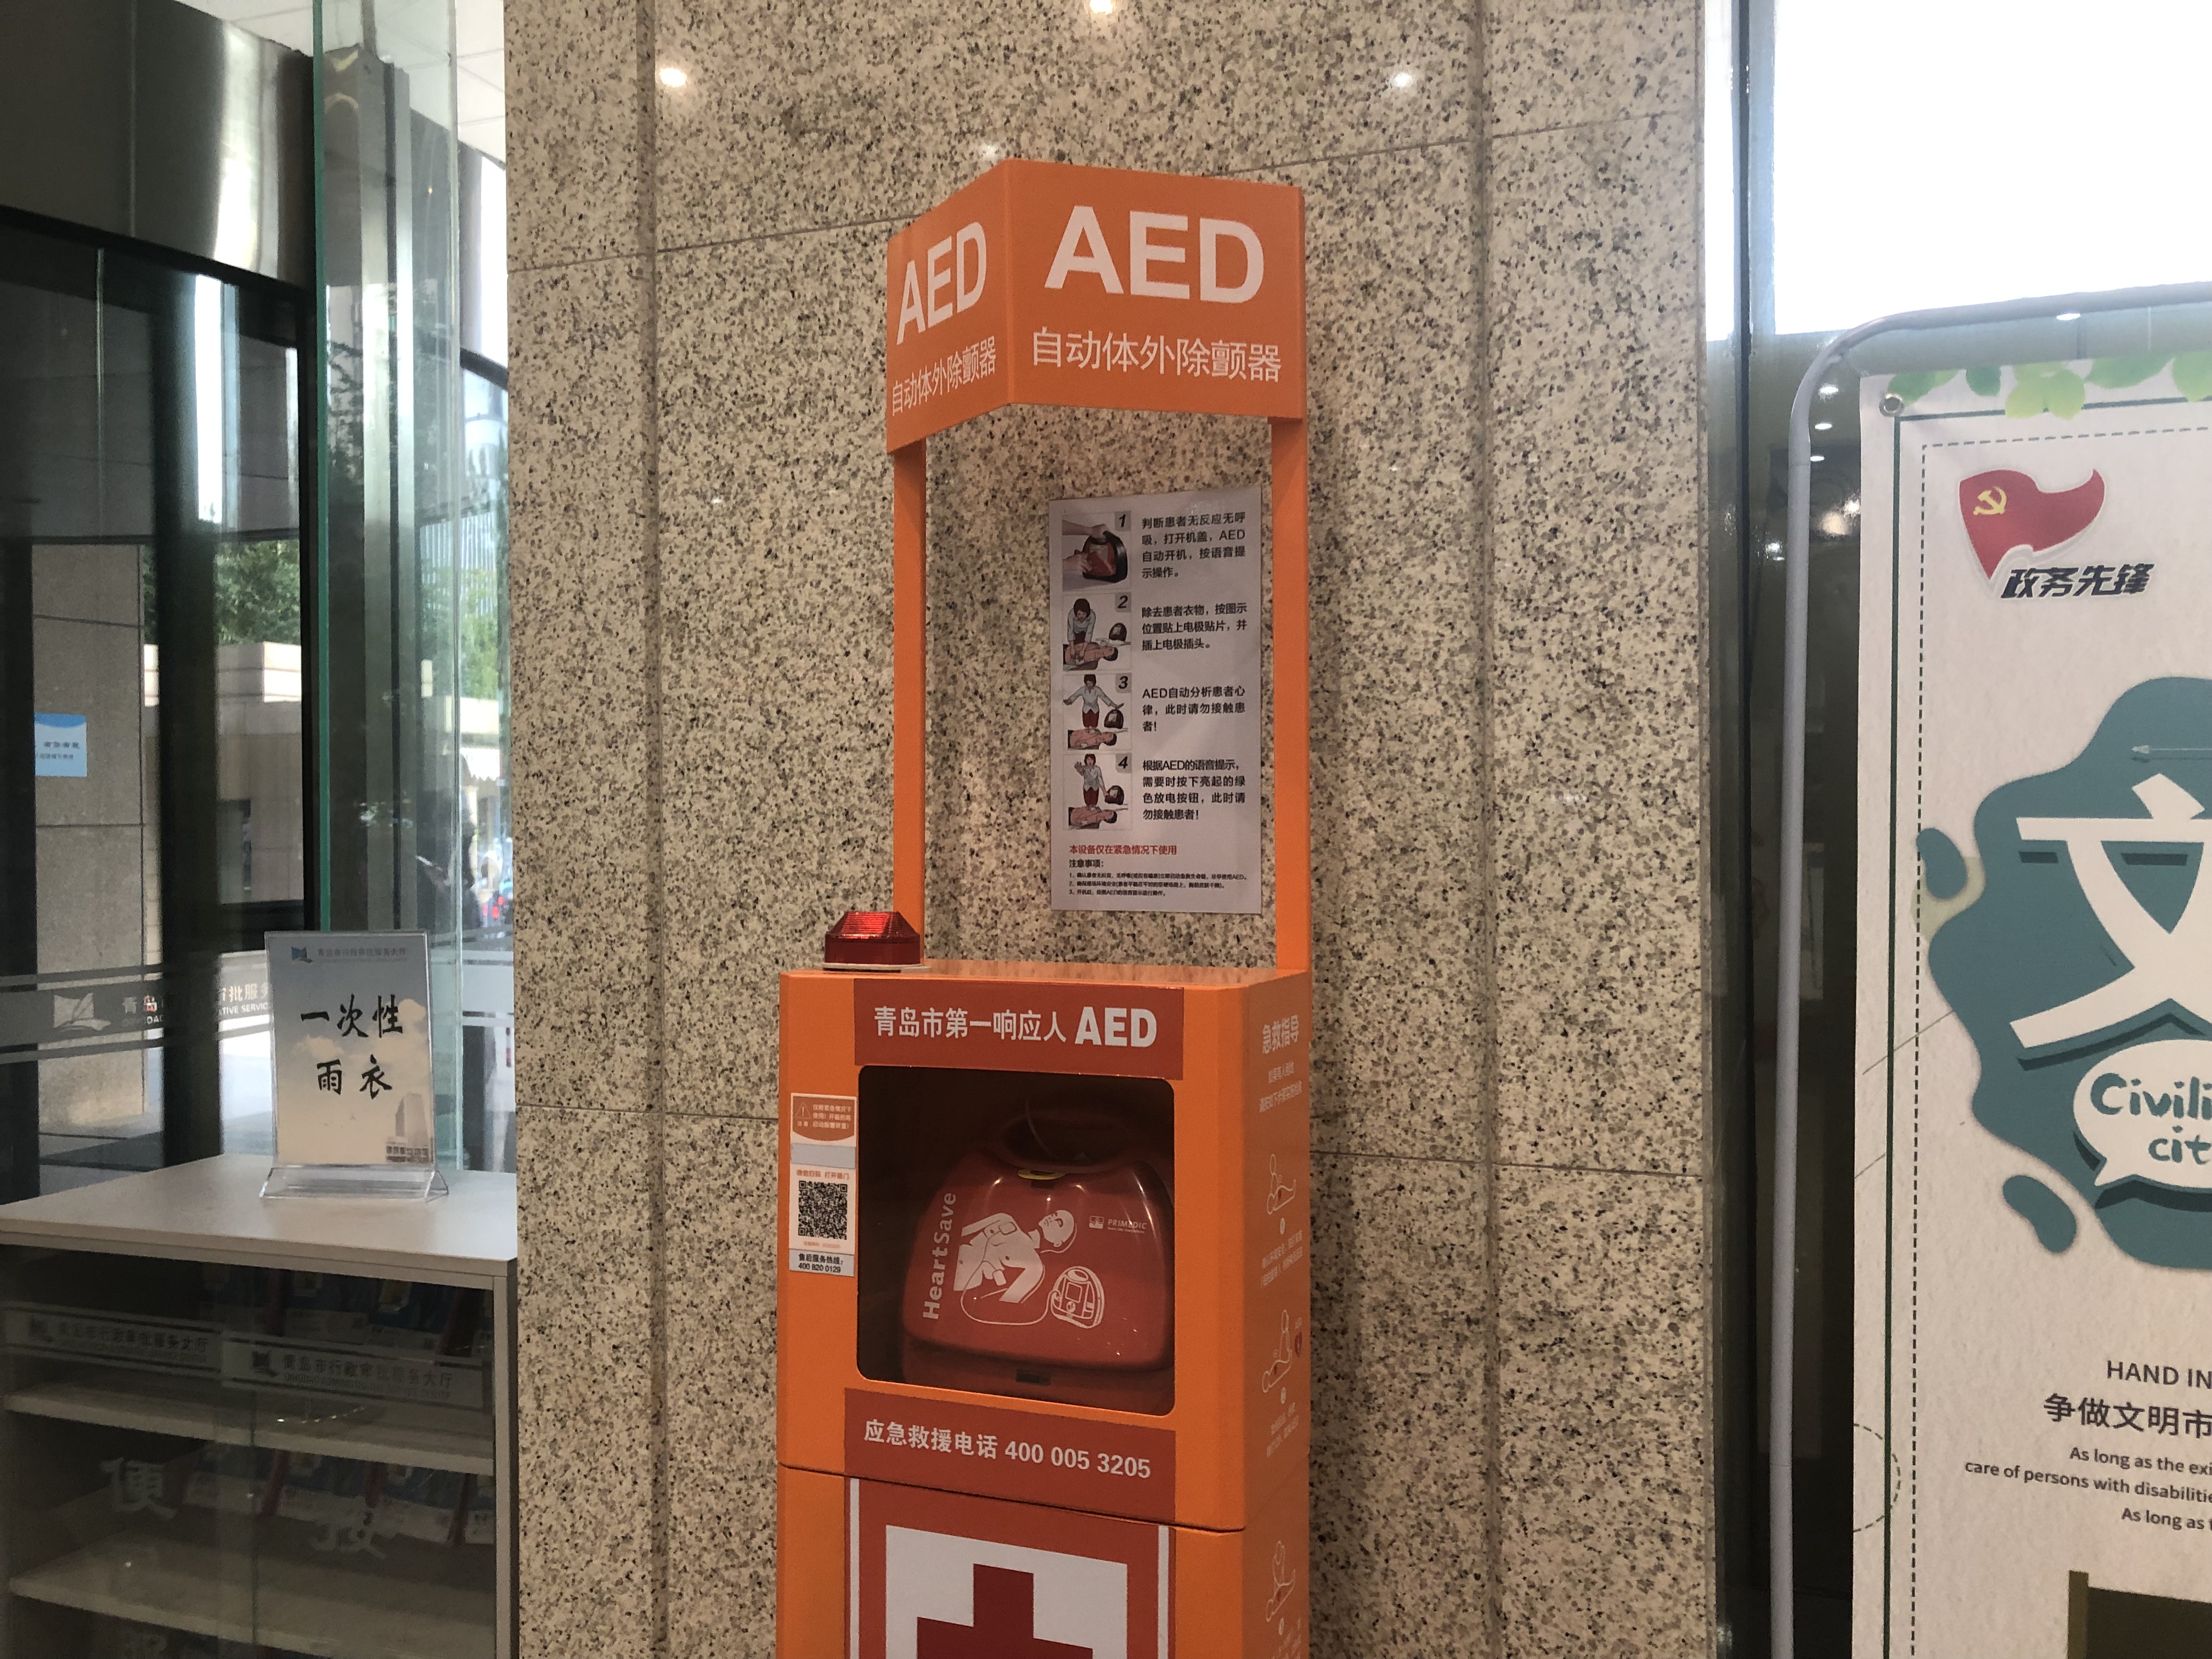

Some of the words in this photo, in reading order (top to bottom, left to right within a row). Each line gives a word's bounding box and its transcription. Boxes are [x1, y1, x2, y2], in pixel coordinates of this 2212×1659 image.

[1044, 205, 1264, 304] AED
[896, 221, 987, 346] AED
[1032, 326, 1282, 382] 自动体外除颤器
[891, 335, 996, 416] 自动体外除颤器
[1118, 514, 1126, 528] 1
[1142, 511, 1246, 529] 判断患者无反应无呼
[1142, 546, 1246, 562] 自动开机，按语音提
[1142, 567, 1179, 579] 示操作。
[2000, 563, 2155, 599] 政务先锋
[1117, 595, 1128, 609] 2
[1142, 602, 1247, 618] 除去患者衣物，按图示
[1142, 619, 1248, 635] 位置贴上电极贴片，并
[1142, 639, 1211, 651] 插上电极插头。
[1118, 676, 1128, 689] 3
[1142, 685, 1246, 699] AED自动分析患者心
[1142, 702, 1246, 716] 律，此时请勿接触患
[1118, 757, 1128, 769] 4
[1142, 759, 1239, 771] 根据AED的语音提示，
[1142, 775, 1246, 788] 需要时按下亮起的绿
[1142, 792, 1246, 804] 色放电按钮，此时请
[1069, 844, 1177, 855] 本设备仅在紧急情况下使用
[300, 994, 403, 1039] 一次性
[874, 1006, 1067, 1042] 青岛市第一响应人
[1074, 1006, 1158, 1048] AED
[316, 1054, 393, 1100] 雨衣
[2090, 1072, 2212, 1120] Civili
[2148, 1125, 2212, 1165] cit
[1107, 1218, 1148, 1230] PRIMEDIC
[923, 1192, 957, 1320] HeartSave
[825, 1265, 841, 1273] 0129
[2106, 1360, 2179, 1386] HAND
[2044, 1392, 2212, 1439] 争做文明市
[864, 1418, 998, 1460] 应急救援电话
[1005, 1441, 1043, 1464] 400
[1051, 1447, 1090, 1470] 005
[1097, 1453, 1151, 1479] 3205
[2069, 1447, 2090, 1462] As
[2094, 1448, 2130, 1470] long
[2134, 1457, 2152, 1469] as
[2157, 1457, 2185, 1472] the
[1965, 1461, 1999, 1476] care
[2004, 1465, 2021, 1478] of
[2024, 1470, 2089, 1488] persons
[2094, 1478, 2130, 1493] with
[2121, 1507, 2141, 1522] As
[2146, 1509, 2182, 1531] long
[2186, 1518, 2205, 1530] as
